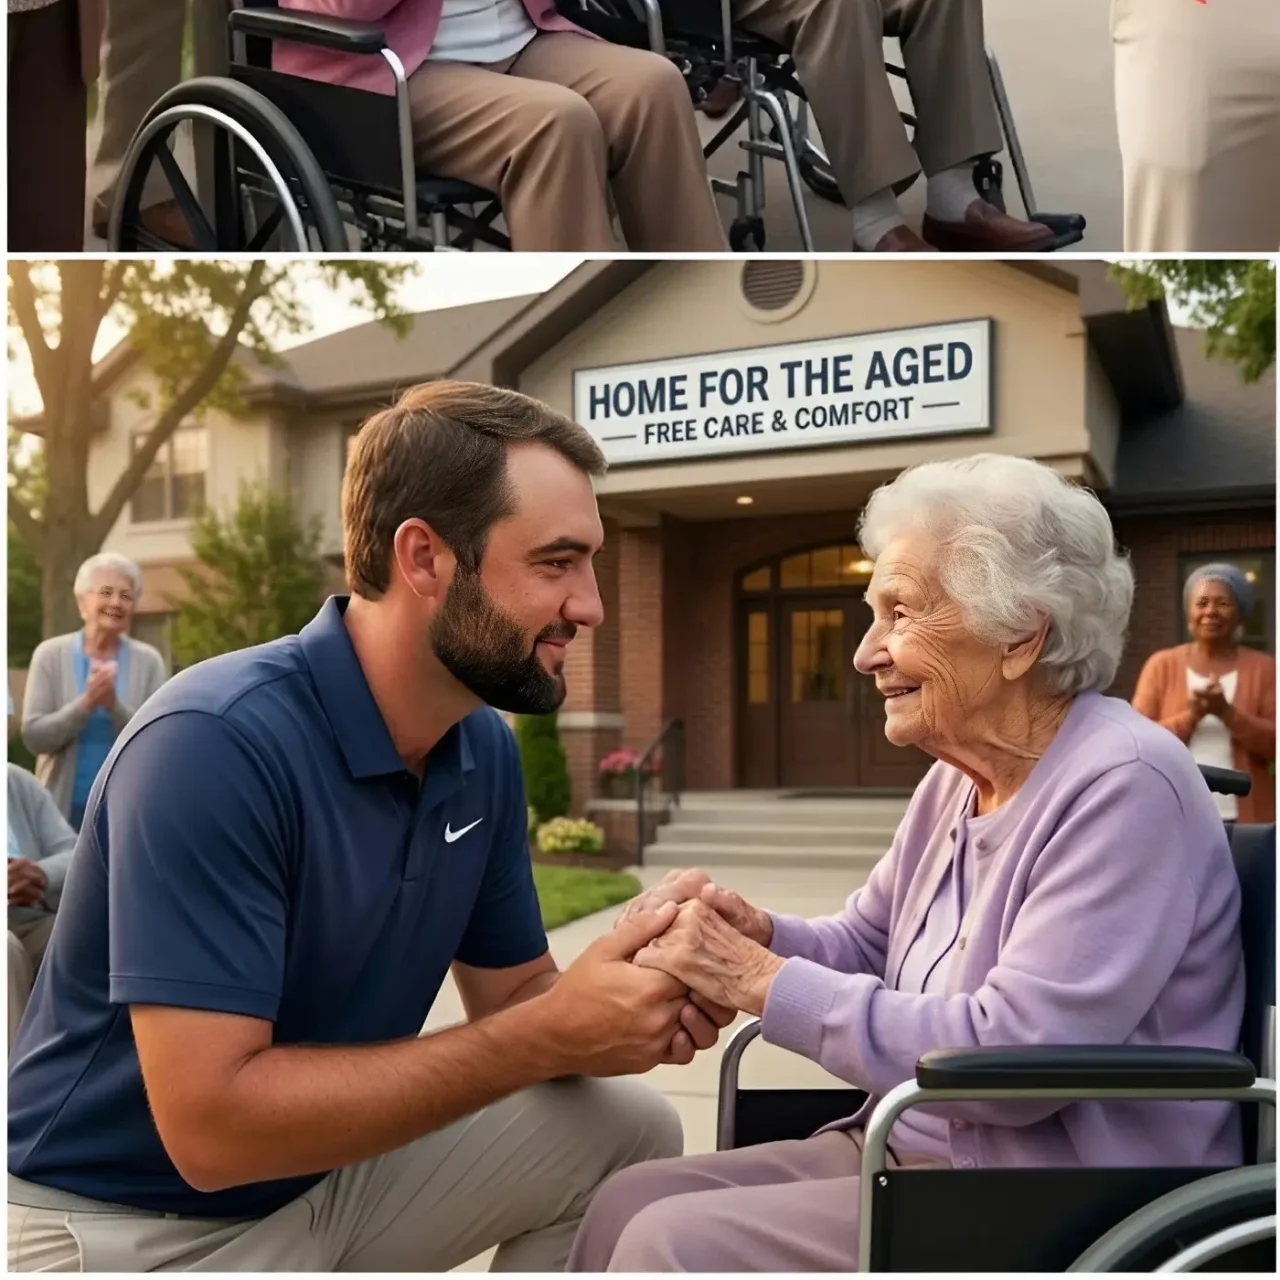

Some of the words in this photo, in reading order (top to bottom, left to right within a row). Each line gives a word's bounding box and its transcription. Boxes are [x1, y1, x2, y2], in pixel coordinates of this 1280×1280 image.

[589, 374, 688, 420] HOME
[699, 365, 769, 408] FOR
[780, 354, 853, 398] THE
[865, 341, 973, 390] AGED
[644, 419, 698, 445] FREE
[703, 412, 765, 439] CARE
[771, 409, 788, 432] &
[794, 396, 914, 430] COMFORT
